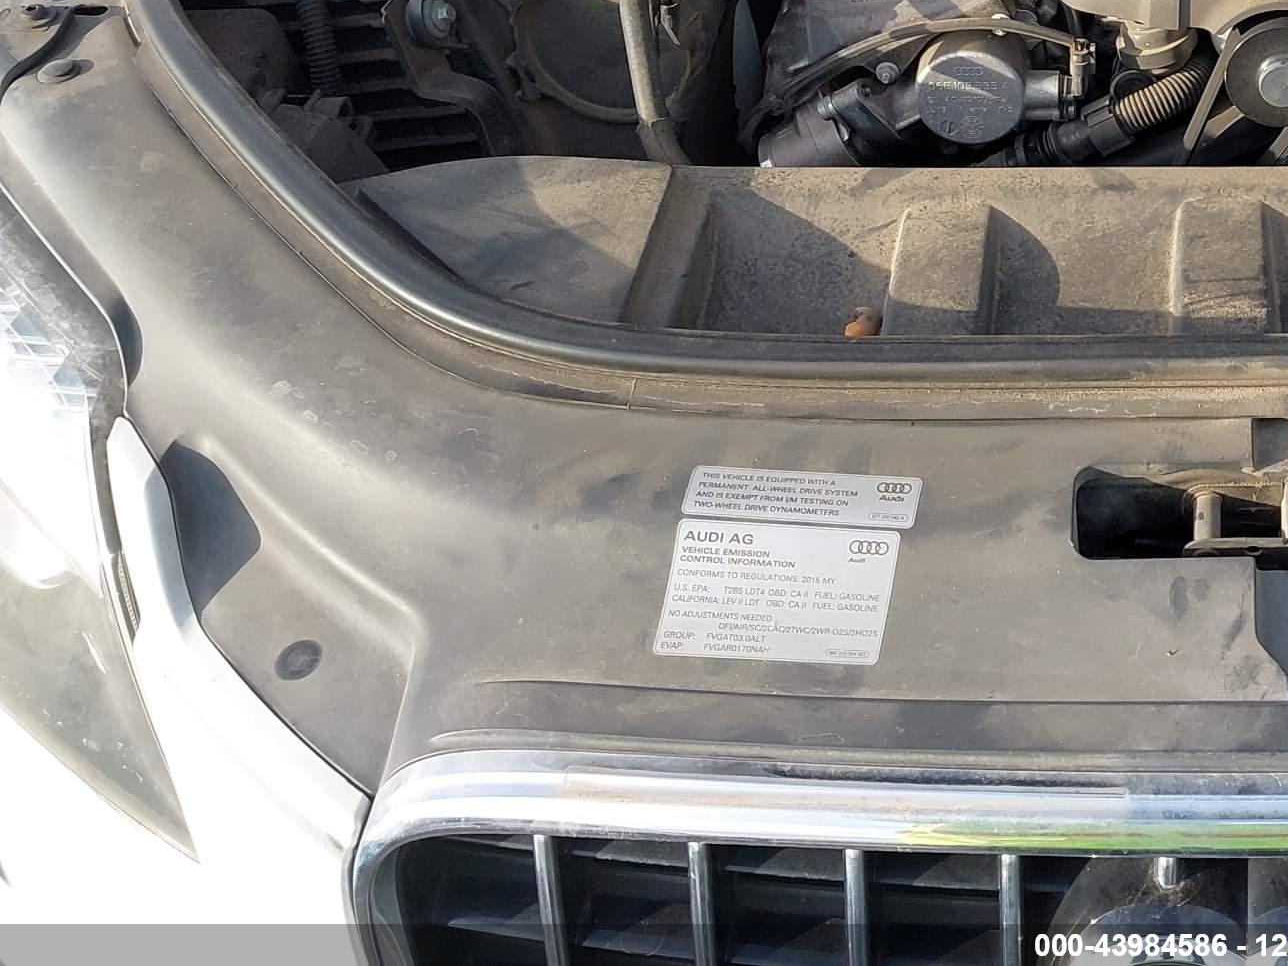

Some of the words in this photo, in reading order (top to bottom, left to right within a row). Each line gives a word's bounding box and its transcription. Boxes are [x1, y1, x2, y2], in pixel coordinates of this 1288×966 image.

[723, 473, 754, 481] VEHICLE
[766, 476, 805, 484] EQUIPPED
[699, 482, 748, 491] PERMANENT
[753, 485, 797, 493] ALL-WHEEL
[726, 493, 758, 501] EXEMPT
[879, 494, 904, 502] Audi
[694, 500, 743, 510] TWO-WHEEL
[745, 504, 767, 512] DRIVE
[770, 505, 839, 516] DYNAMOMETERS
[684, 530, 724, 544] AUDI
[728, 533, 754, 545] AG
[682, 546, 720, 555] VEHICLE
[723, 548, 770, 558] EMISSION
[680, 555, 725, 564] CONTROL
[728, 558, 796, 568] INFORMATION
[678, 569, 725, 578] CONFORMS
[727, 571, 738, 579] TO
[740, 572, 799, 583] REGULATIONS:
[674, 584, 689, 592] U.S.
[791, 590, 801, 598] CA
[840, 593, 880, 602] GASOLINE
[672, 594, 720, 604] CALIFORNIA:
[837, 603, 879, 612] GASOLINE
[682, 611, 739, 620] ADJUSTMENTS
[664, 631, 695, 639] GROUP:
